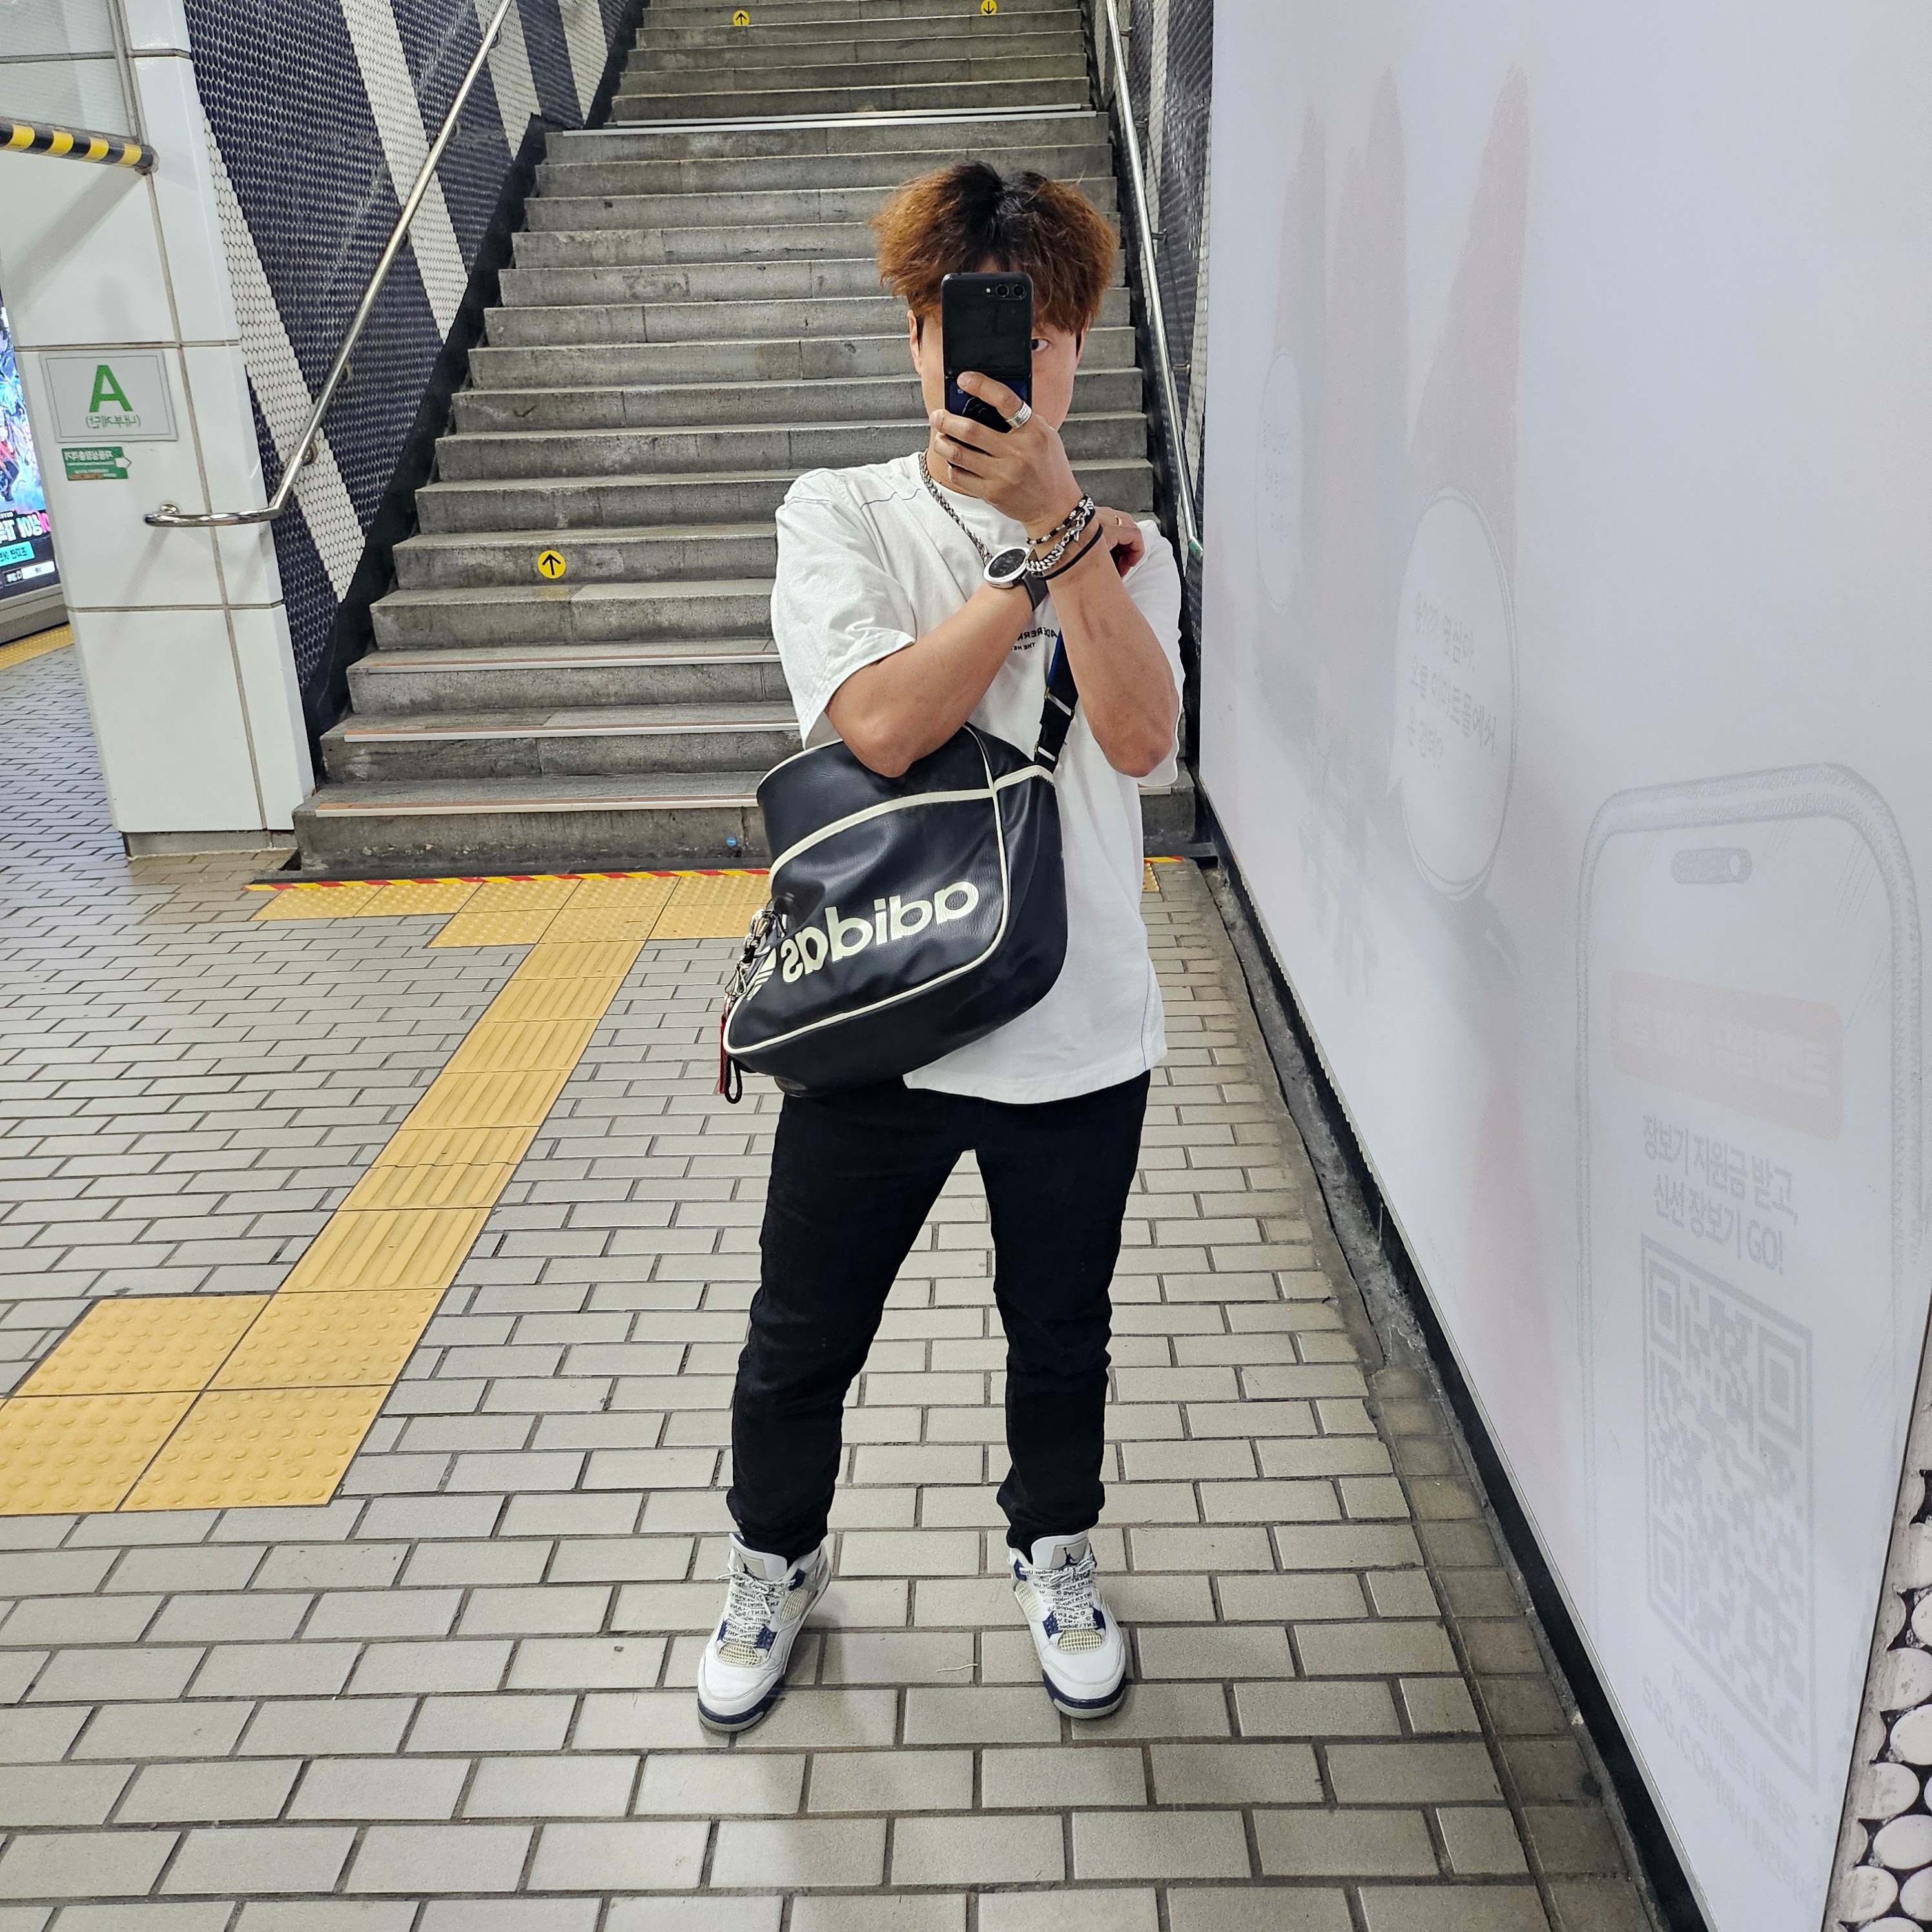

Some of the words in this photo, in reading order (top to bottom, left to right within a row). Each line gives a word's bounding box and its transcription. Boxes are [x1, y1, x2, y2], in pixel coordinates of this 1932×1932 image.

[1643, 1114, 1690, 1177] 장보기
[1693, 1135, 1748, 1201] 지원금
[1751, 1155, 1799, 1226] 받고,
[1653, 1174, 1685, 1229] 신선
[1687, 1187, 1742, 1261] 장보기
[1746, 1218, 1785, 1276] GO!
